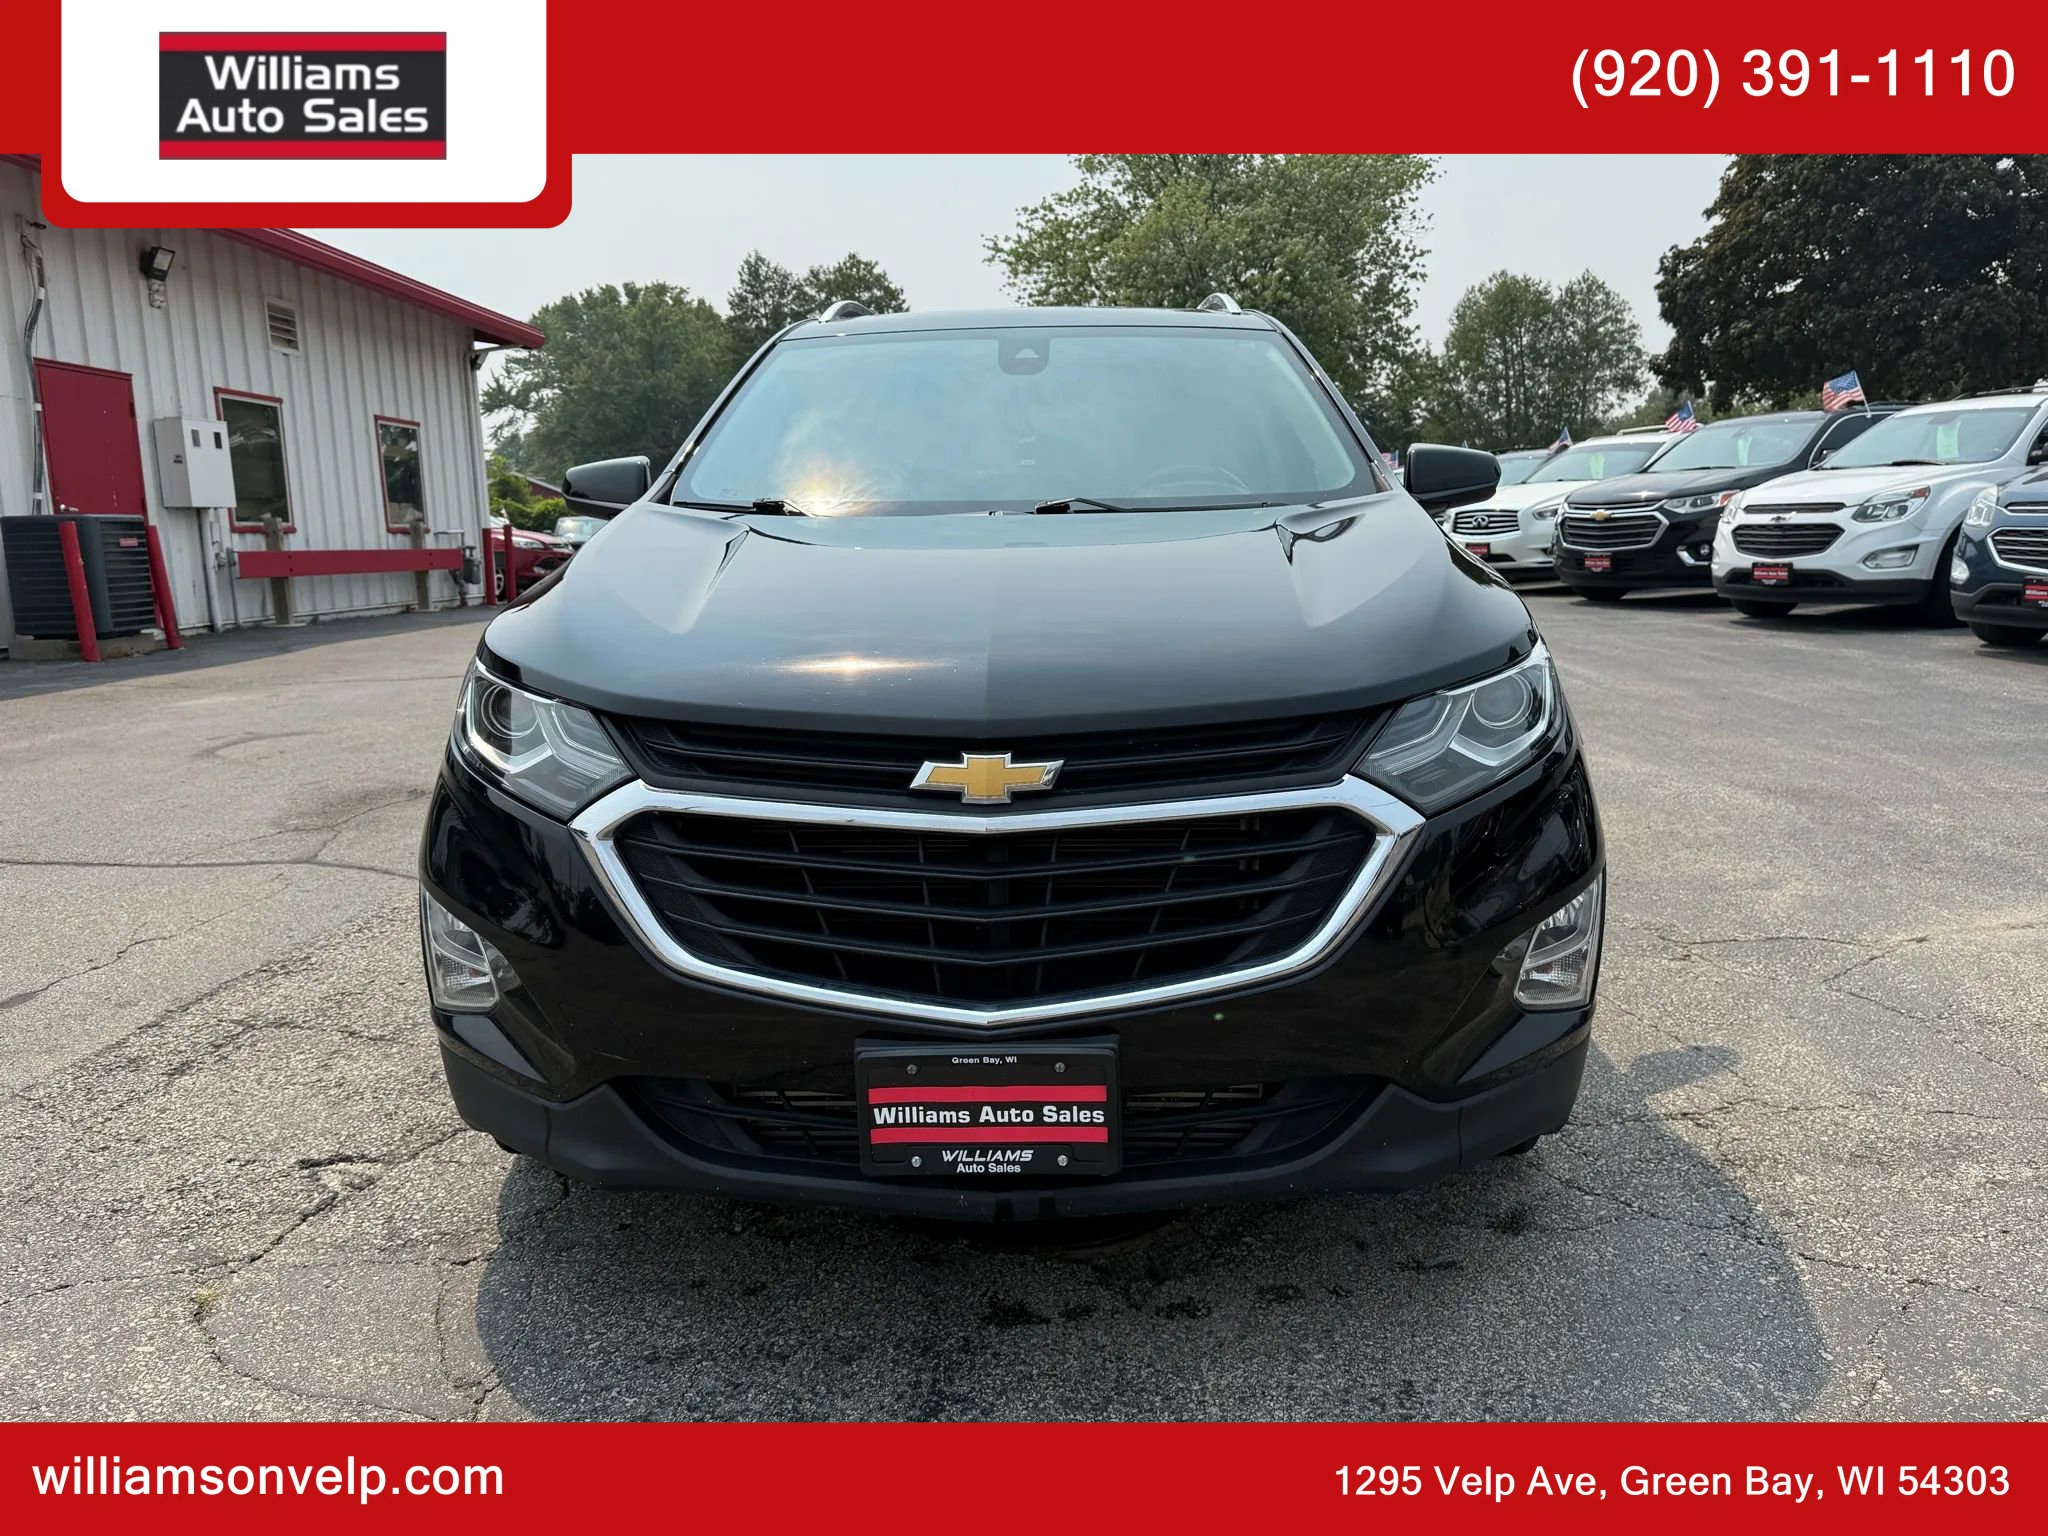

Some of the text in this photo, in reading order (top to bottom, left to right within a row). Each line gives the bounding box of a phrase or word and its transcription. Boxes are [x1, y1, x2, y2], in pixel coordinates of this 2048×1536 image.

[952, 1056, 980, 1064] Green
[983, 1056, 1003, 1065] Bay,
[873, 1105, 1105, 1125] Williams Auto Sales
[942, 1149, 1034, 1162] WILLIAMS
[956, 1163, 1021, 1173] Auto Sales
